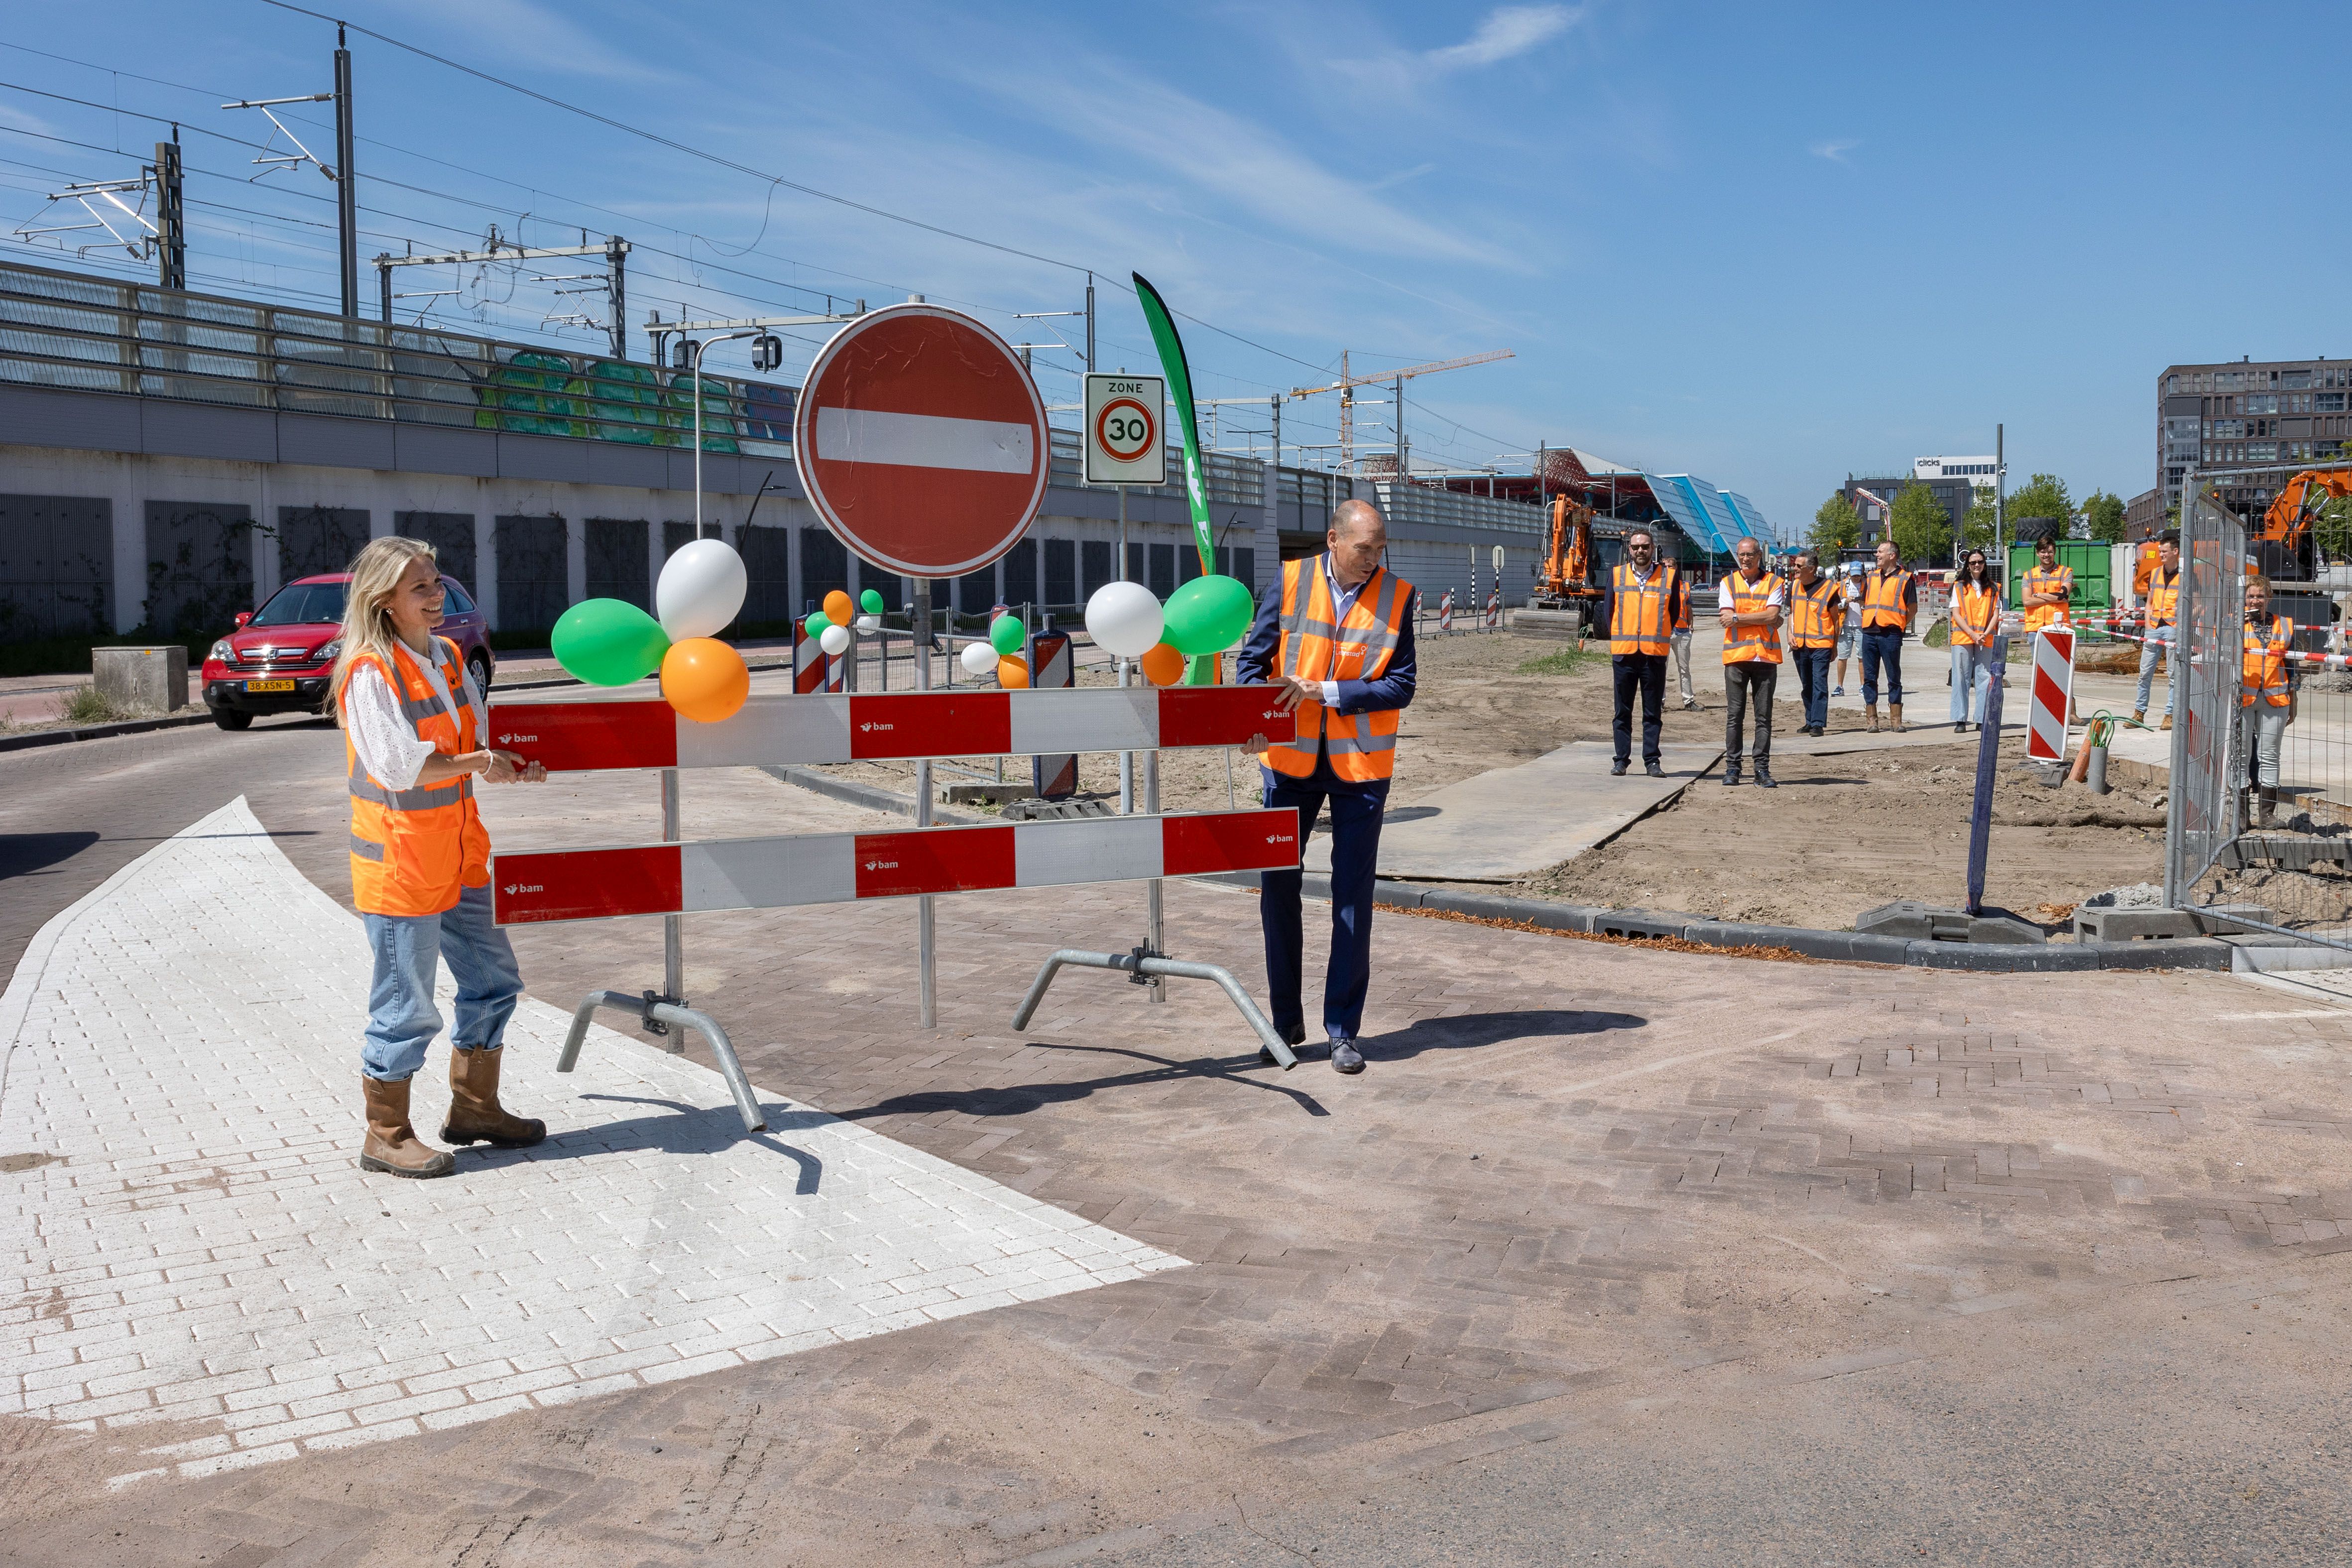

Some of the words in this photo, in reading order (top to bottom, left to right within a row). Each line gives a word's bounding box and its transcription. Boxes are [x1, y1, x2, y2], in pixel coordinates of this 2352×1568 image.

[1108, 382, 1143, 393] ZONE
[1109, 418, 1145, 441] 30
[250, 681, 291, 690] 38-XSN-5
[873, 722, 894, 730] bam
[514, 733, 538, 742] bam
[878, 860, 899, 869] bam
[520, 883, 543, 893] bam
